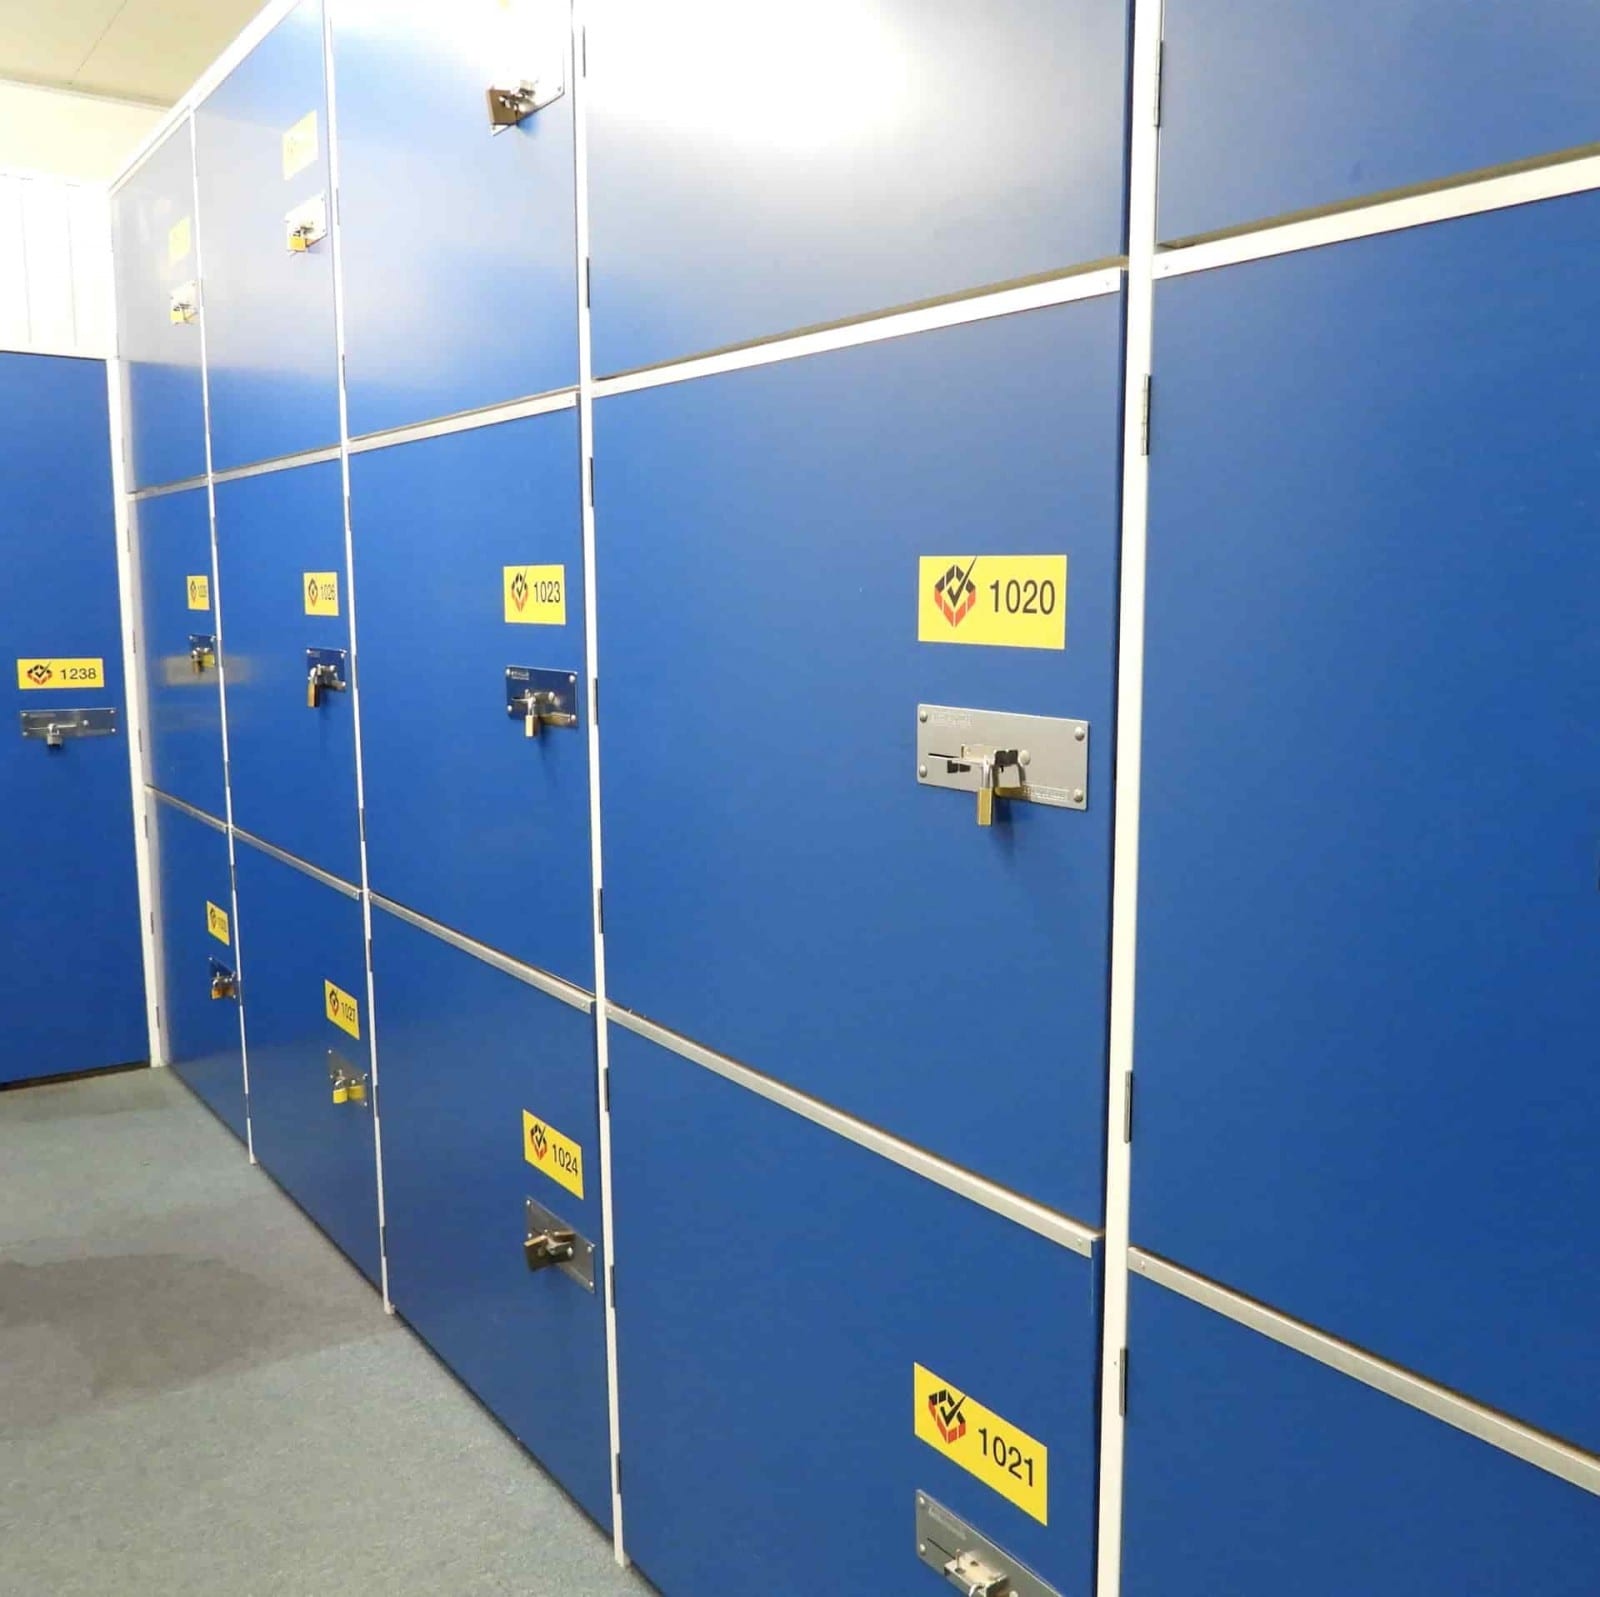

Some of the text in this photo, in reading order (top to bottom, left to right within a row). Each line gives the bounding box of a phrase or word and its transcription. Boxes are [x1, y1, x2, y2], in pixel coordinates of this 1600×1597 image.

[534, 581, 561, 603] 1023
[990, 579, 1055, 615] 1020
[60, 667, 97, 680] 1238
[341, 1002, 356, 1022] 1027
[552, 1144, 578, 1176] 1024
[978, 1427, 1033, 1487] 1021
